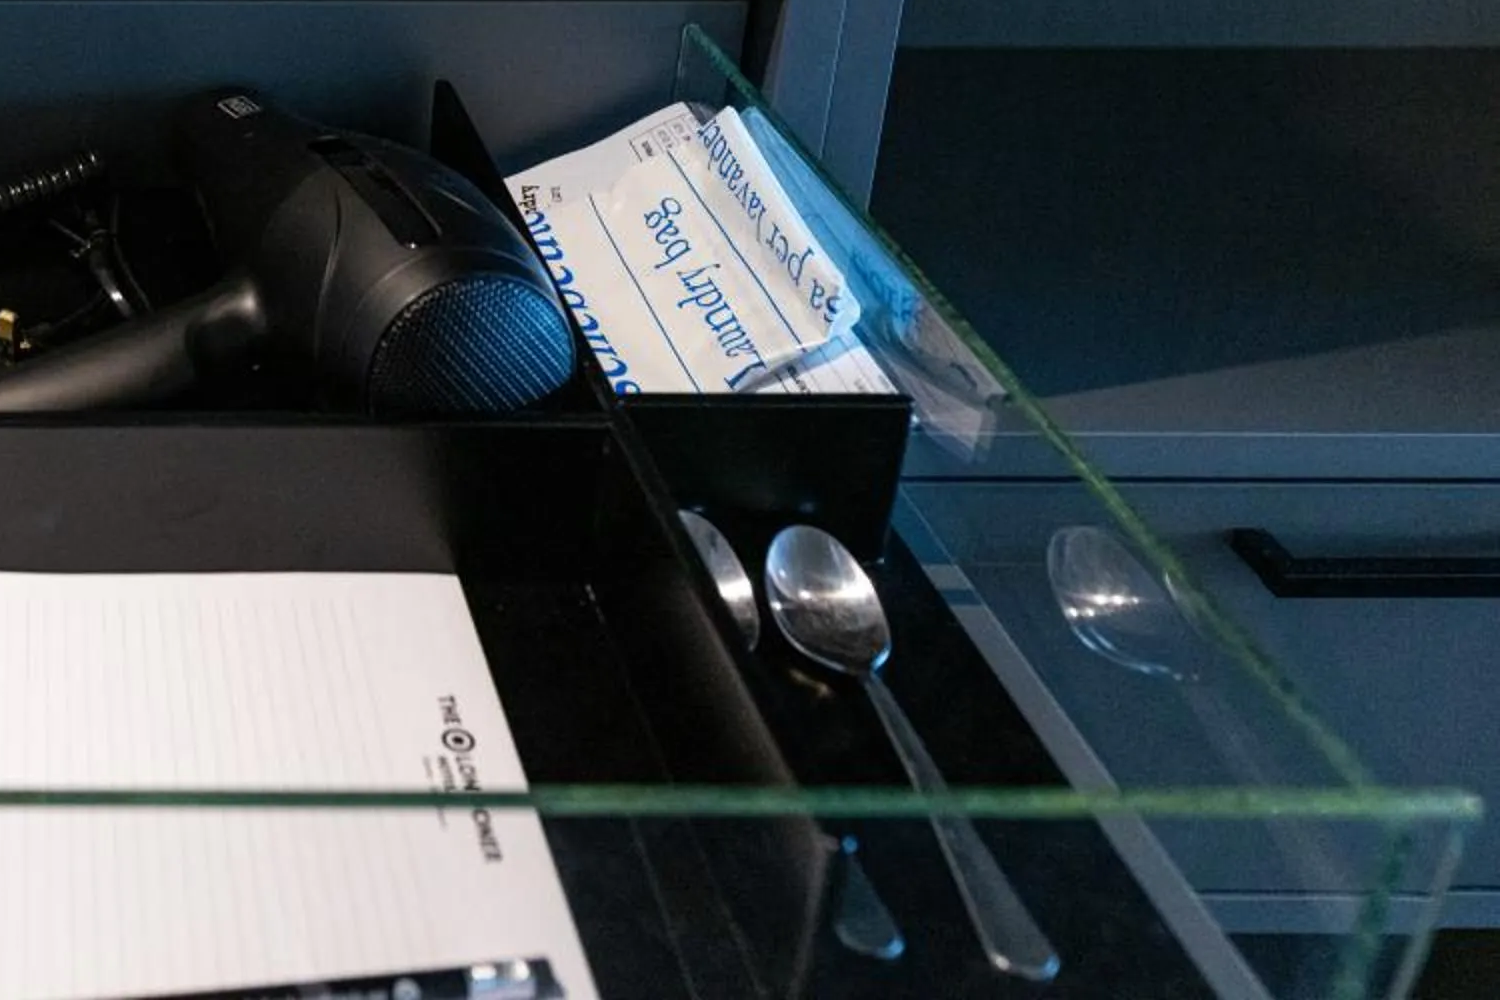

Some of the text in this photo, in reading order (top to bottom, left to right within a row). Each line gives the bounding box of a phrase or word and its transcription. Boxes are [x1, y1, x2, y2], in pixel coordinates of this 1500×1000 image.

[644, 197, 691, 269] bag
[766, 222, 815, 286] per
[676, 263, 767, 389] Laundry
